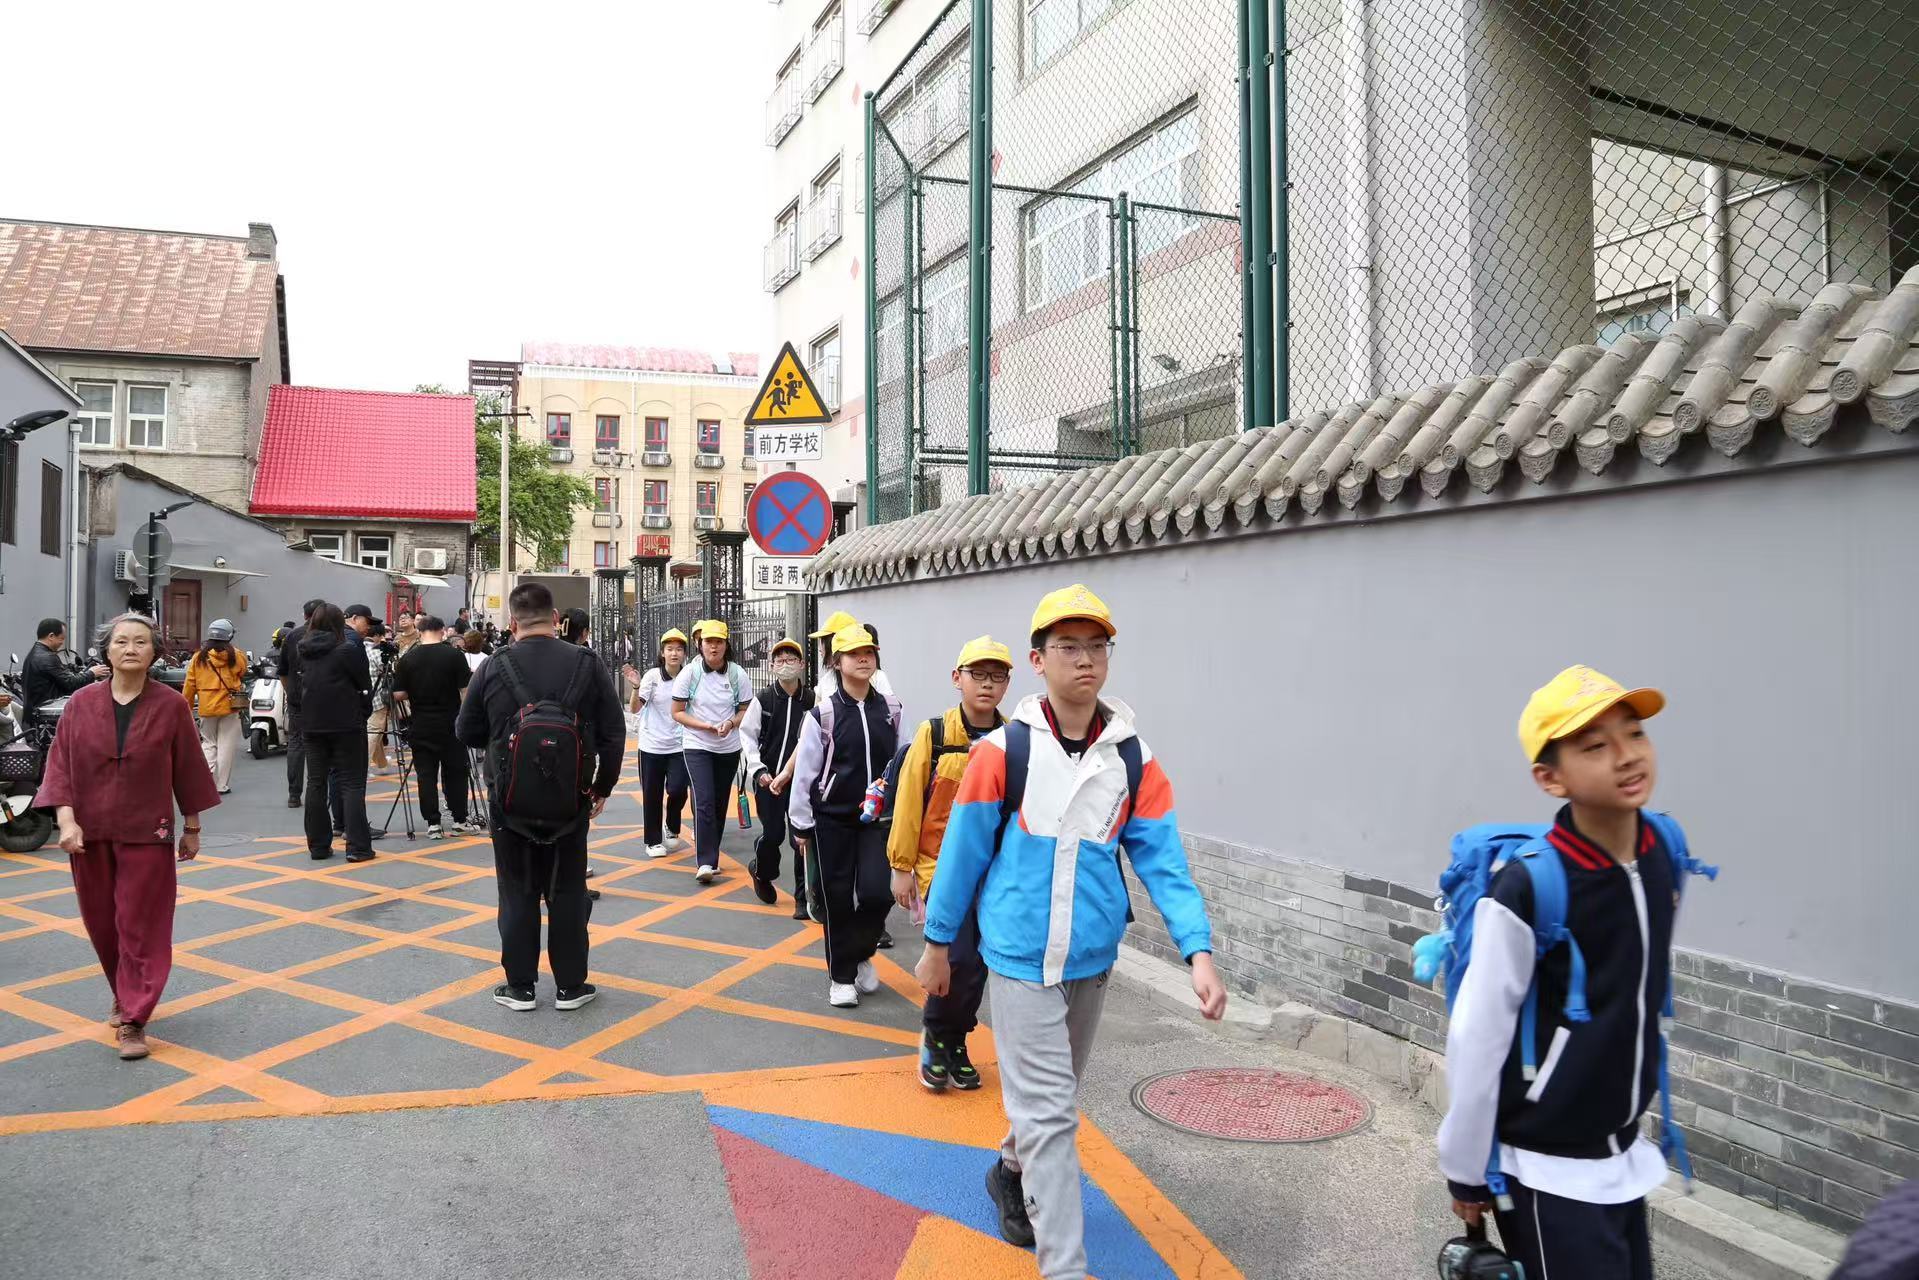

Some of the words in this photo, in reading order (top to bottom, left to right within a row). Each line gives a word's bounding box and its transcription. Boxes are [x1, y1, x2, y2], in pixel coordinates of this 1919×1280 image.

[759, 432, 818, 455] 前方学校
[758, 564, 806, 585] 道路两
[1104, 816, 1113, 829] AND
